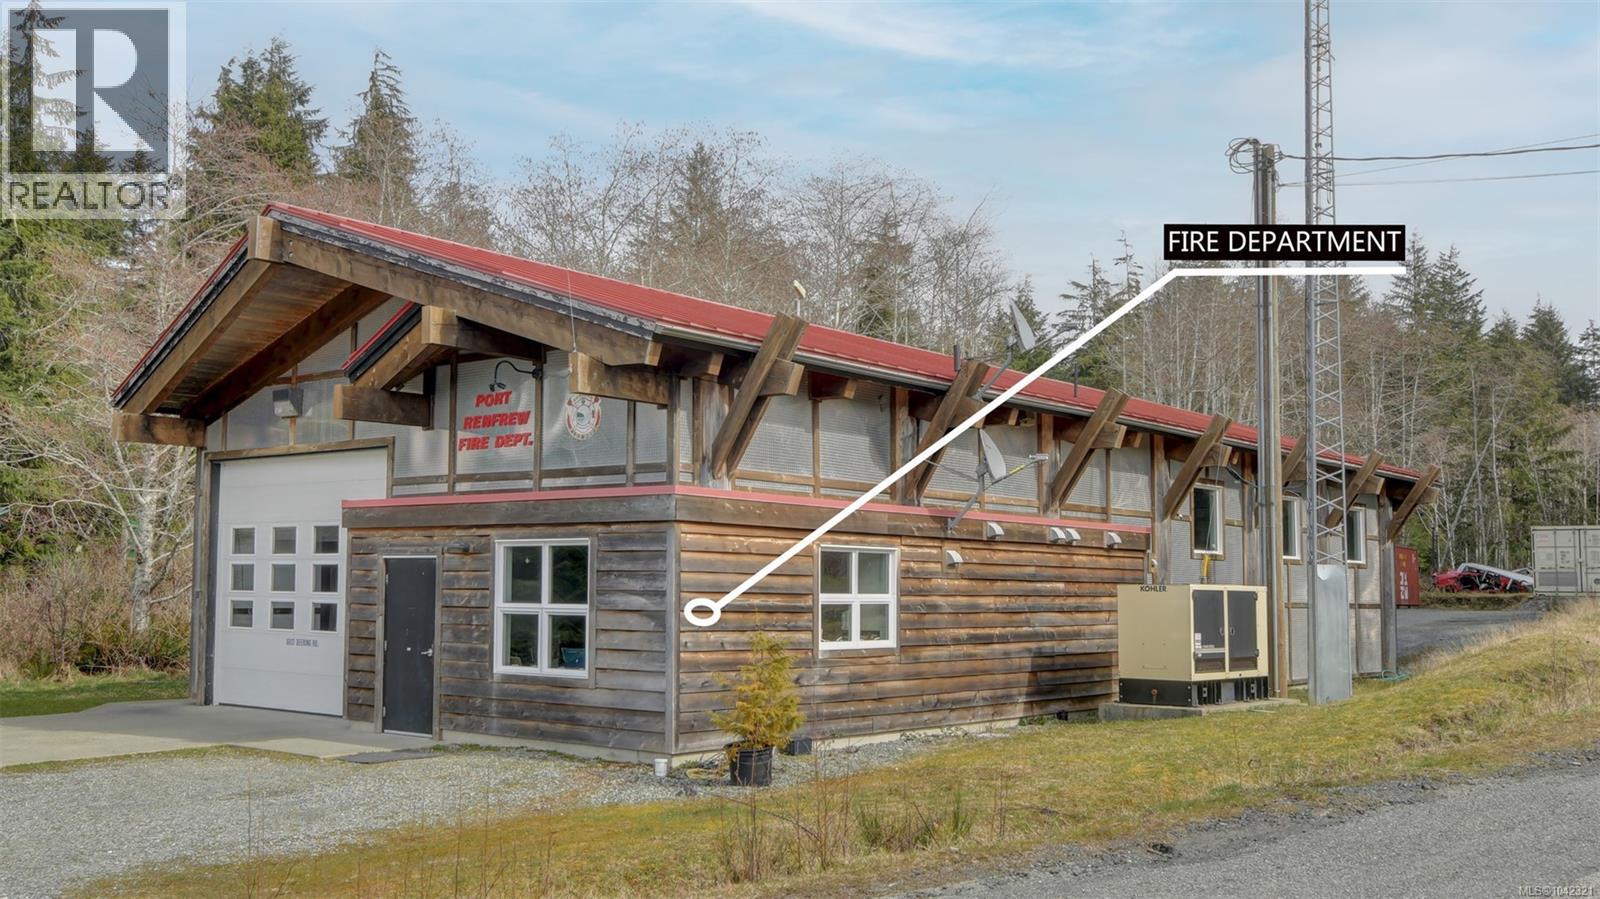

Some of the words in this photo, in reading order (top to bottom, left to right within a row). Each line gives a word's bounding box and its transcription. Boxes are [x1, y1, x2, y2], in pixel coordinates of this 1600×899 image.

[475, 391, 513, 408] PORT
[463, 411, 531, 429] RENFREW
[458, 436, 490, 451] FIRE
[494, 432, 534, 449] DEPT.
